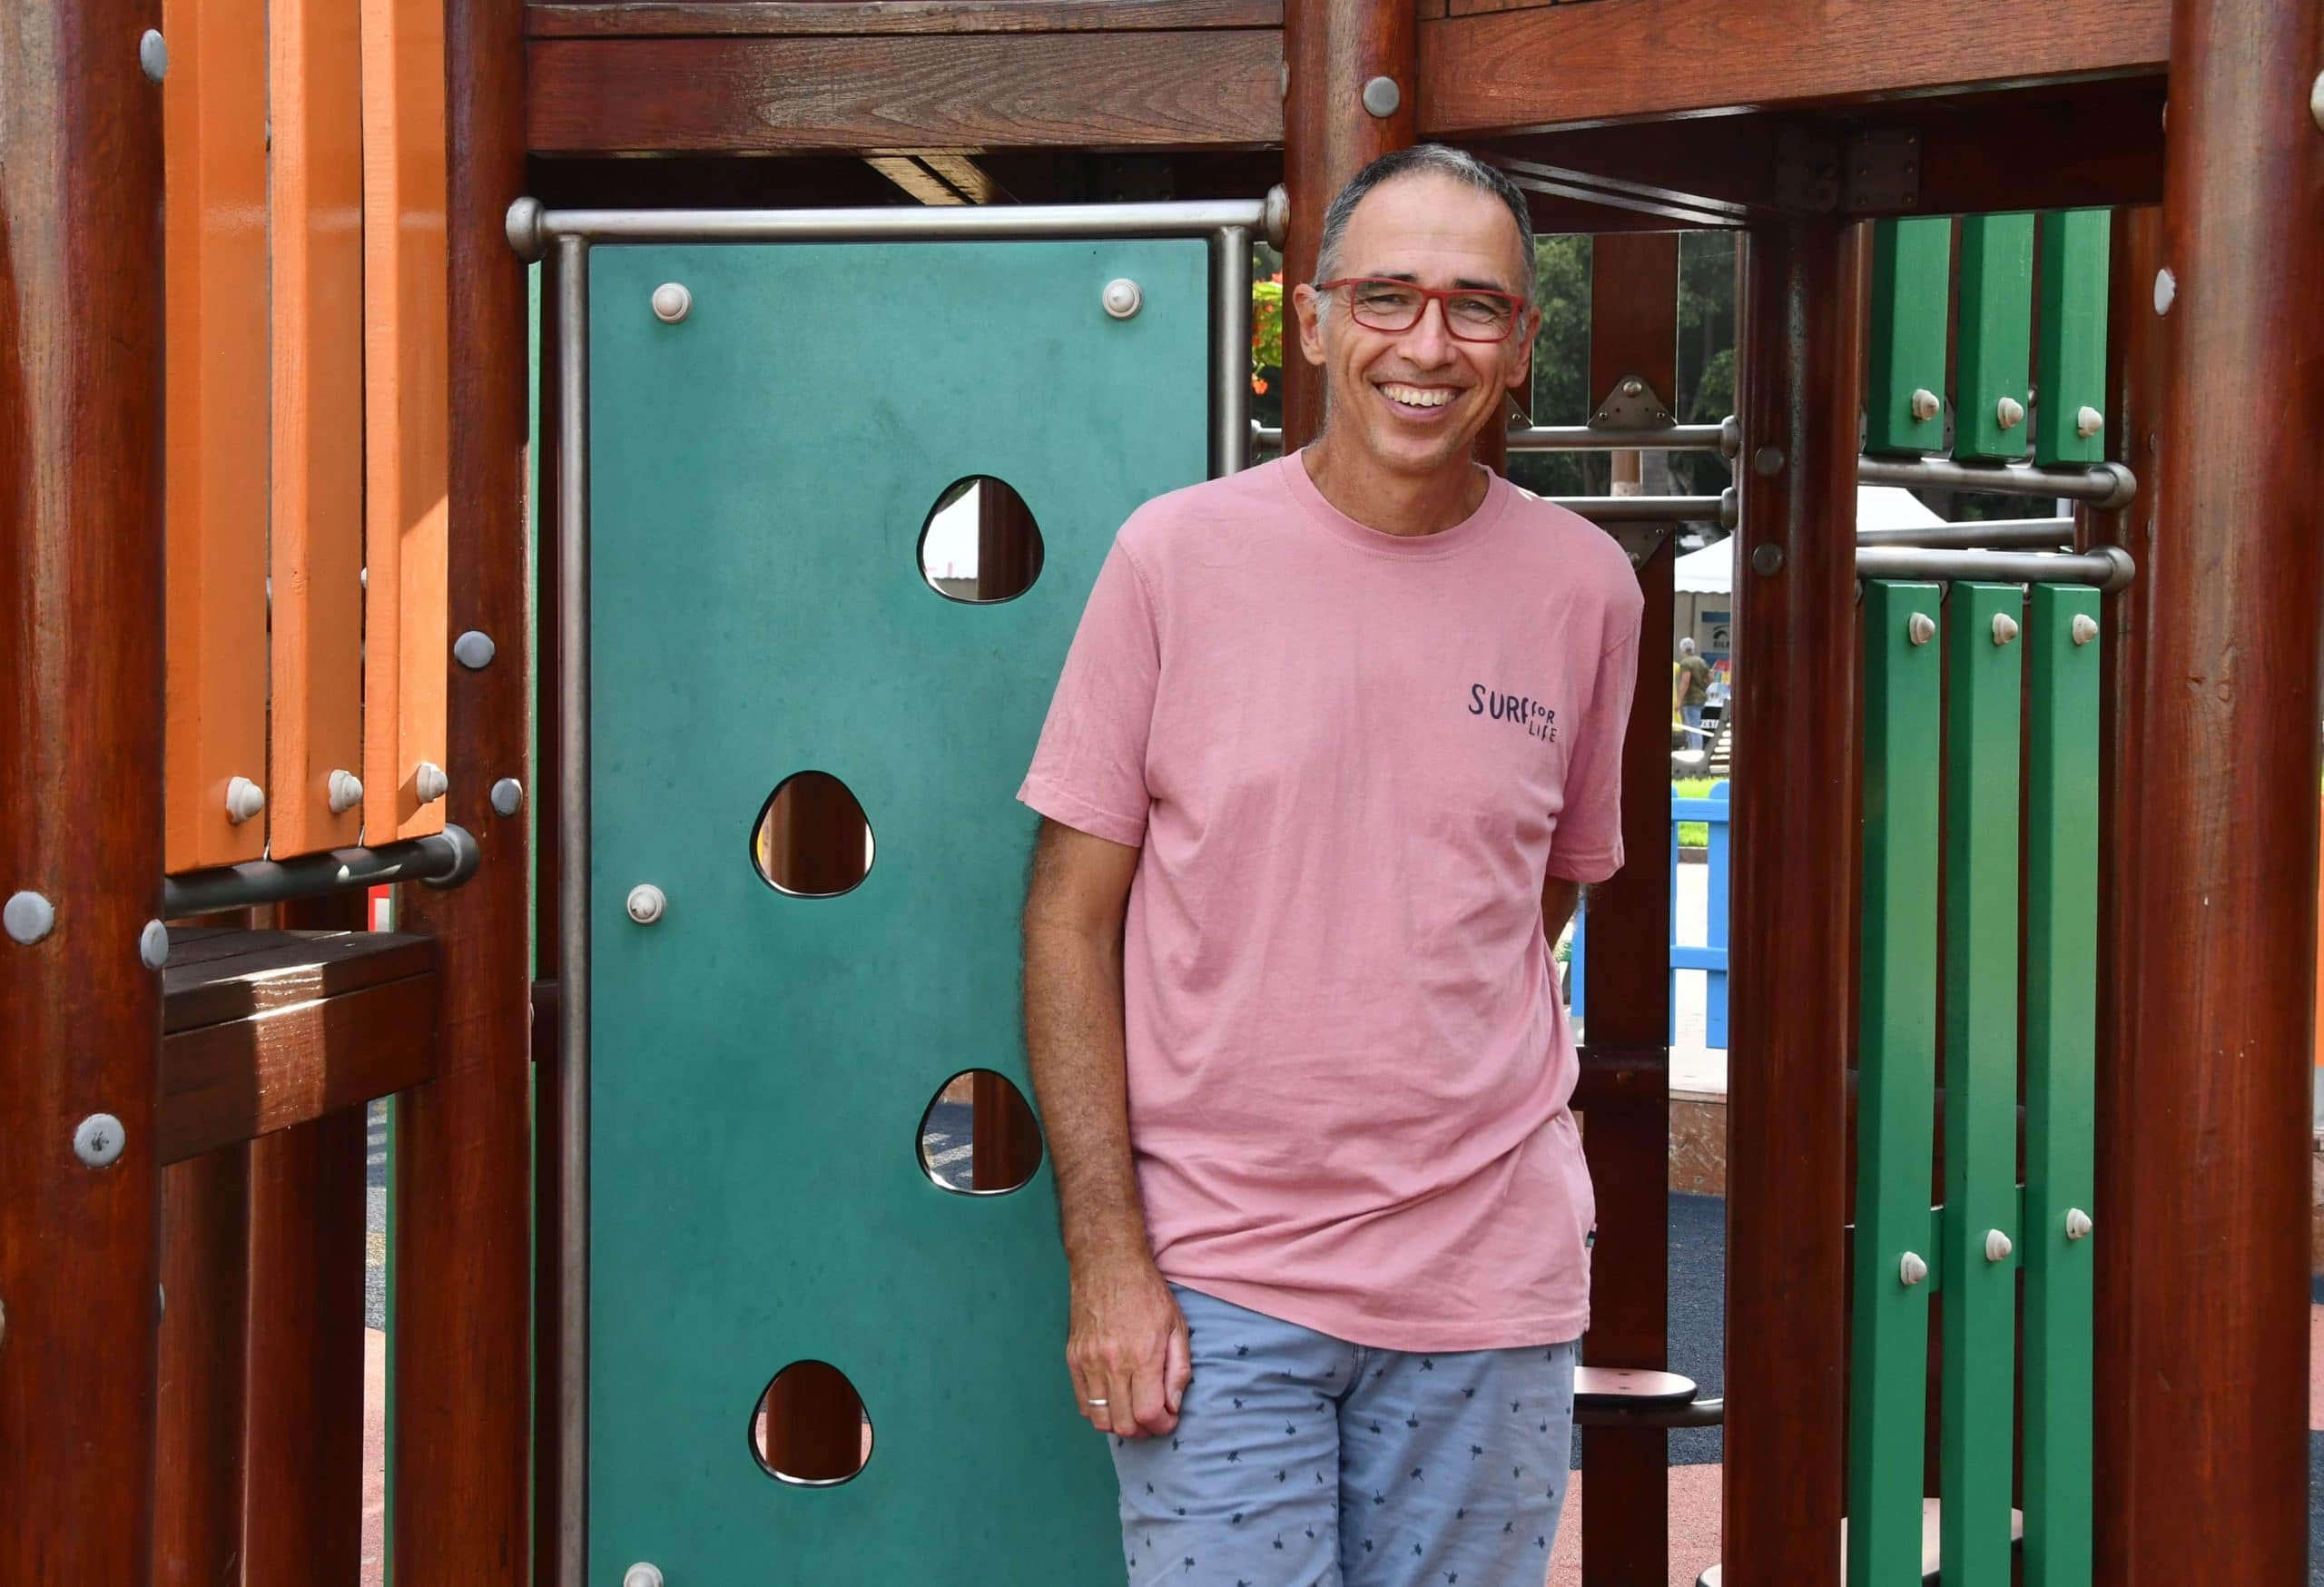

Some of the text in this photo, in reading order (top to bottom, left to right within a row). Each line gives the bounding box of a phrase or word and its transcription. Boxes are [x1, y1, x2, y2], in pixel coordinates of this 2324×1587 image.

[1468, 684, 1555, 724] SURF FOR
[1529, 720, 1558, 743] LIFE
